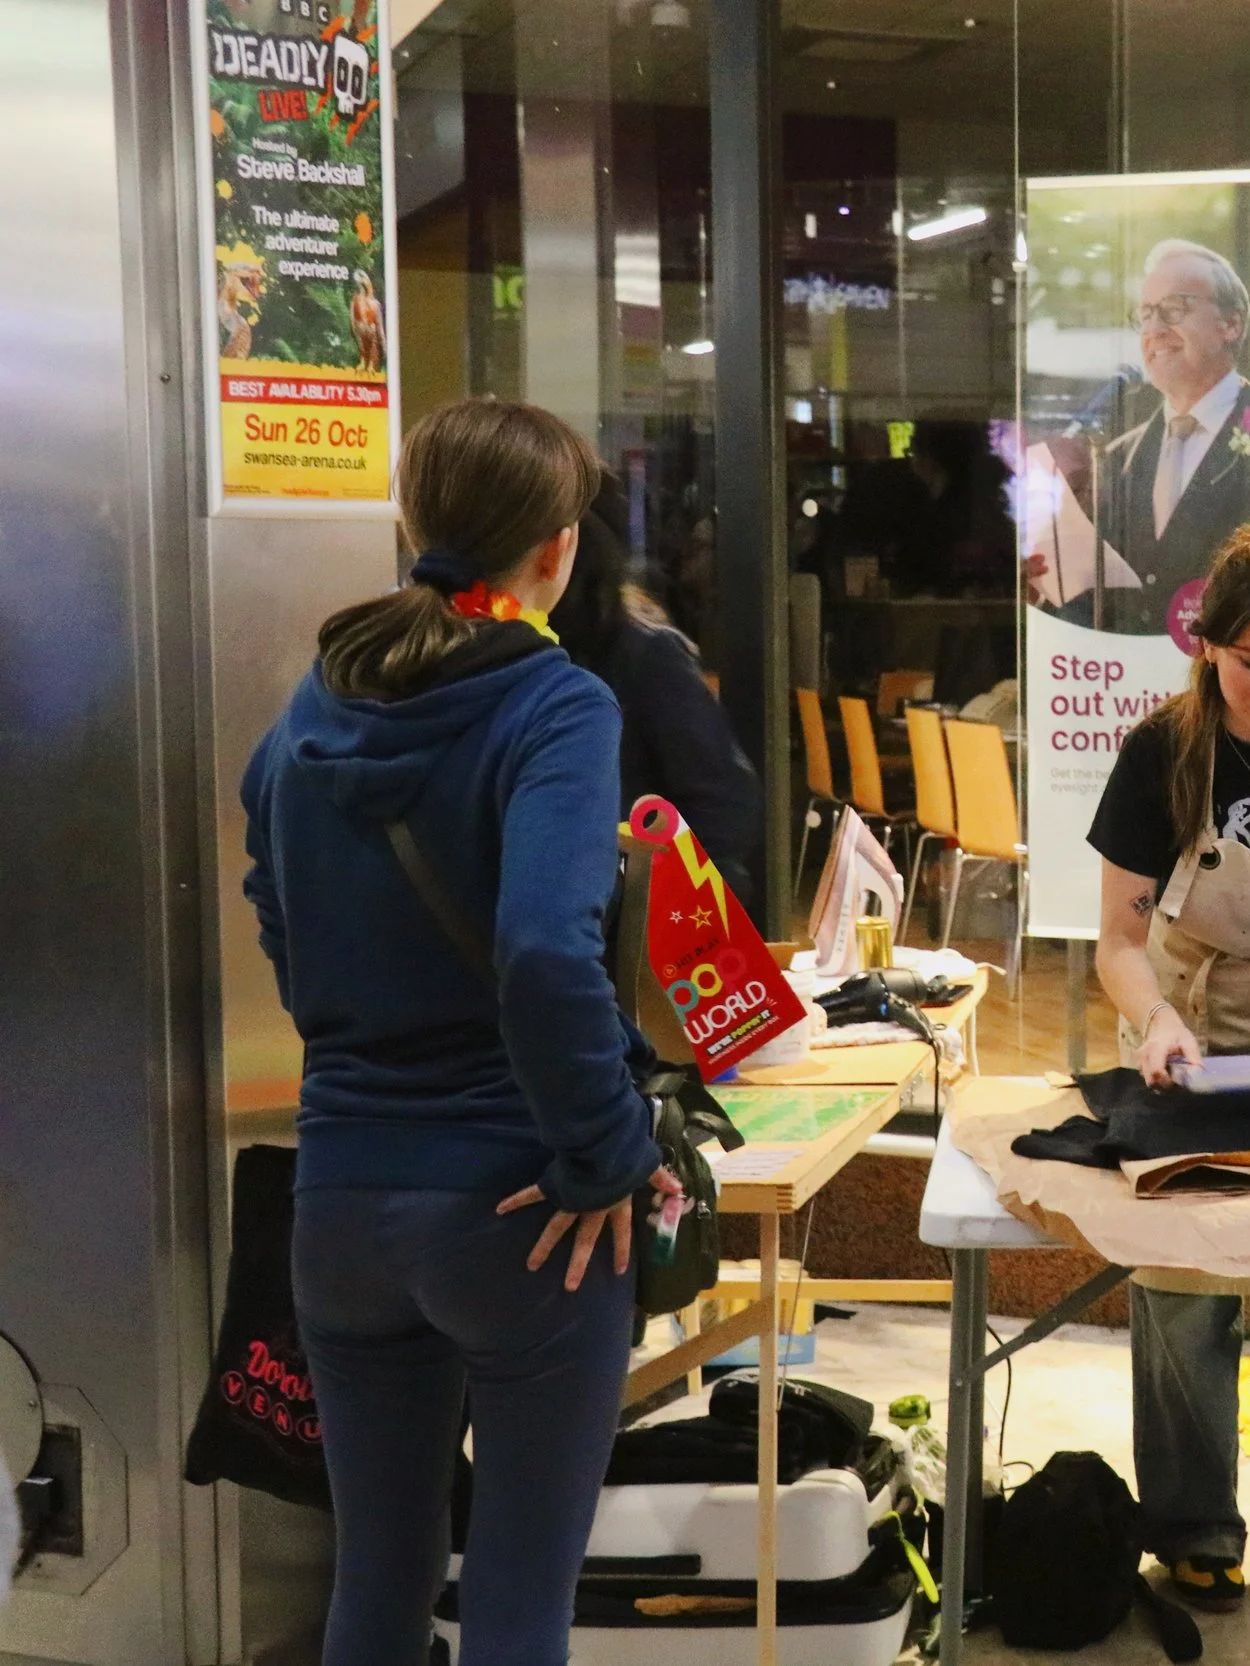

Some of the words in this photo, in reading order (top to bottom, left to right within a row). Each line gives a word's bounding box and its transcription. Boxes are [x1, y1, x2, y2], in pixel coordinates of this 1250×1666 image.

[212, 31, 328, 89] DEADLY
[258, 90, 309, 122] LIVE!
[237, 154, 295, 181] Steve
[297, 158, 366, 187] Backshall
[252, 205, 283, 227] The
[285, 210, 339, 234] ultimate
[279, 258, 349, 281] experience
[228, 380, 265, 398] BEST
[269, 382, 345, 402] AVAILABILITY
[245, 413, 288, 443] Sun
[295, 418, 321, 445] 26
[328, 420, 369, 449] Oct
[244, 451, 368, 471] swansea-arena.co.uk
[1050, 653, 1124, 689] Step
[1050, 691, 1105, 717] out
[683, 981, 766, 1044] WORLD
